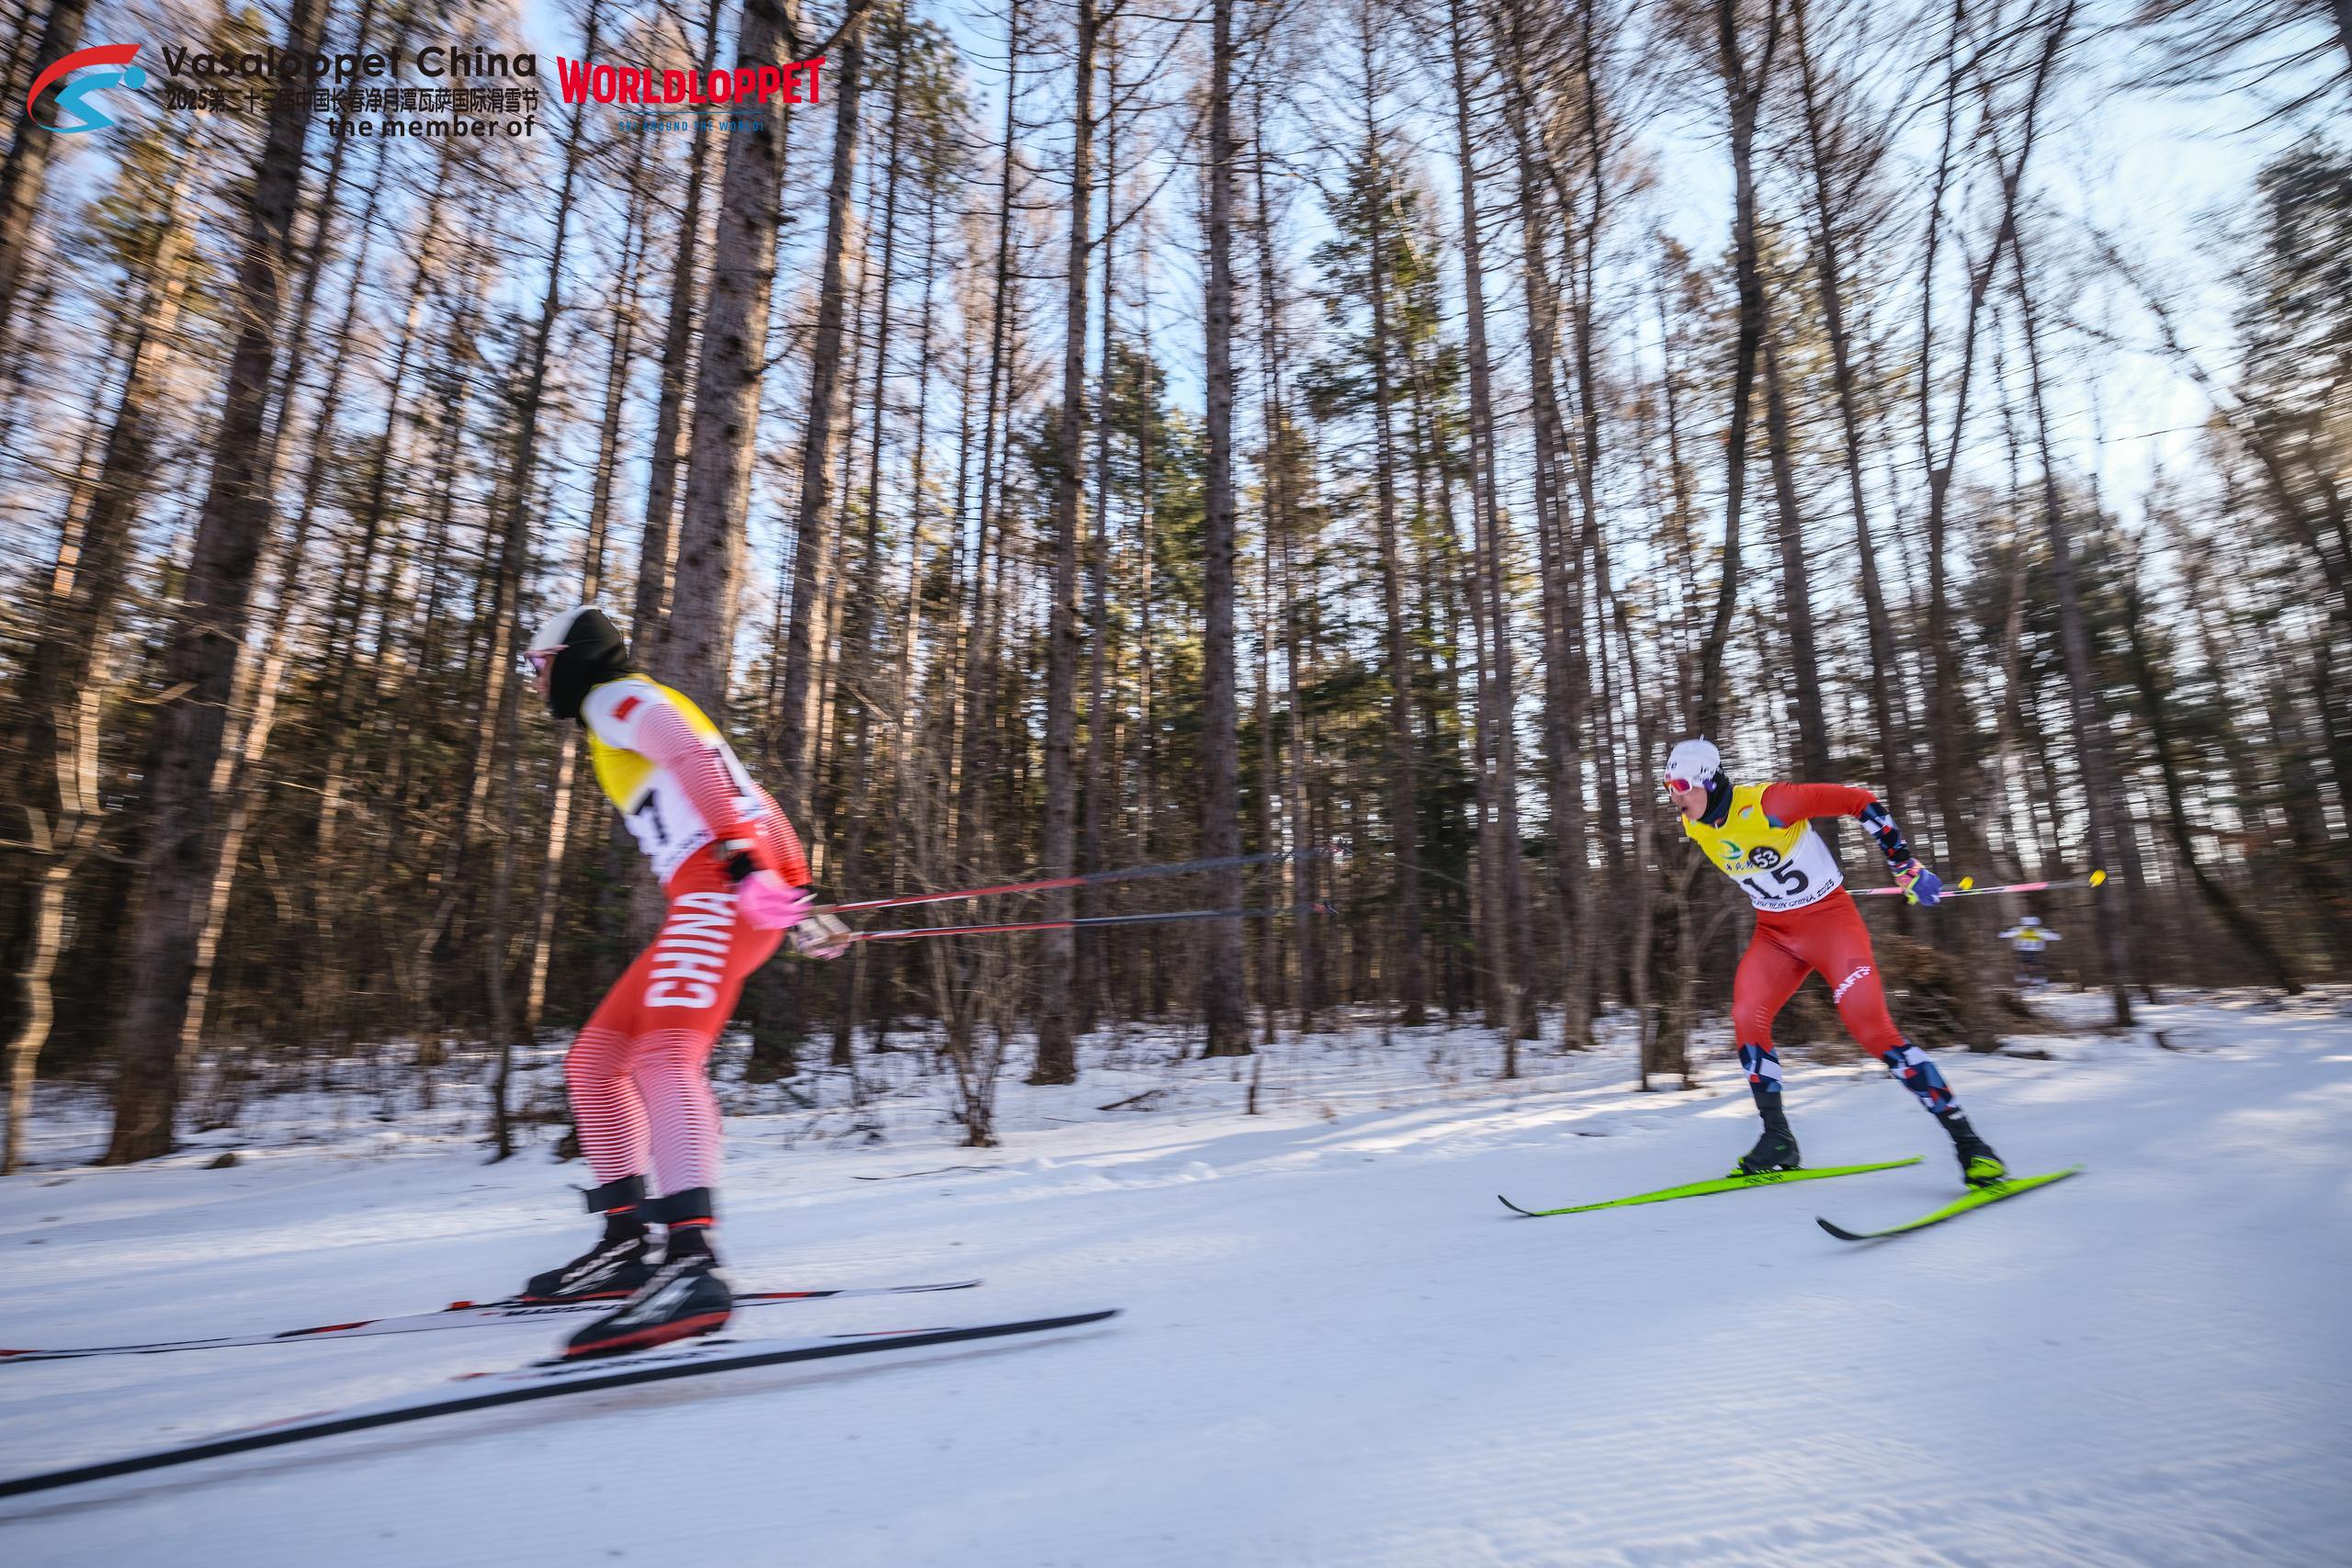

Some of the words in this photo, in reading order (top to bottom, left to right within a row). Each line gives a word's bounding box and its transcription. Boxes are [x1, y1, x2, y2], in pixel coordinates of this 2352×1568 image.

[1742, 858, 1809, 900] 15
[1752, 850, 1779, 869] 53
[643, 892, 741, 1009] CHINA
